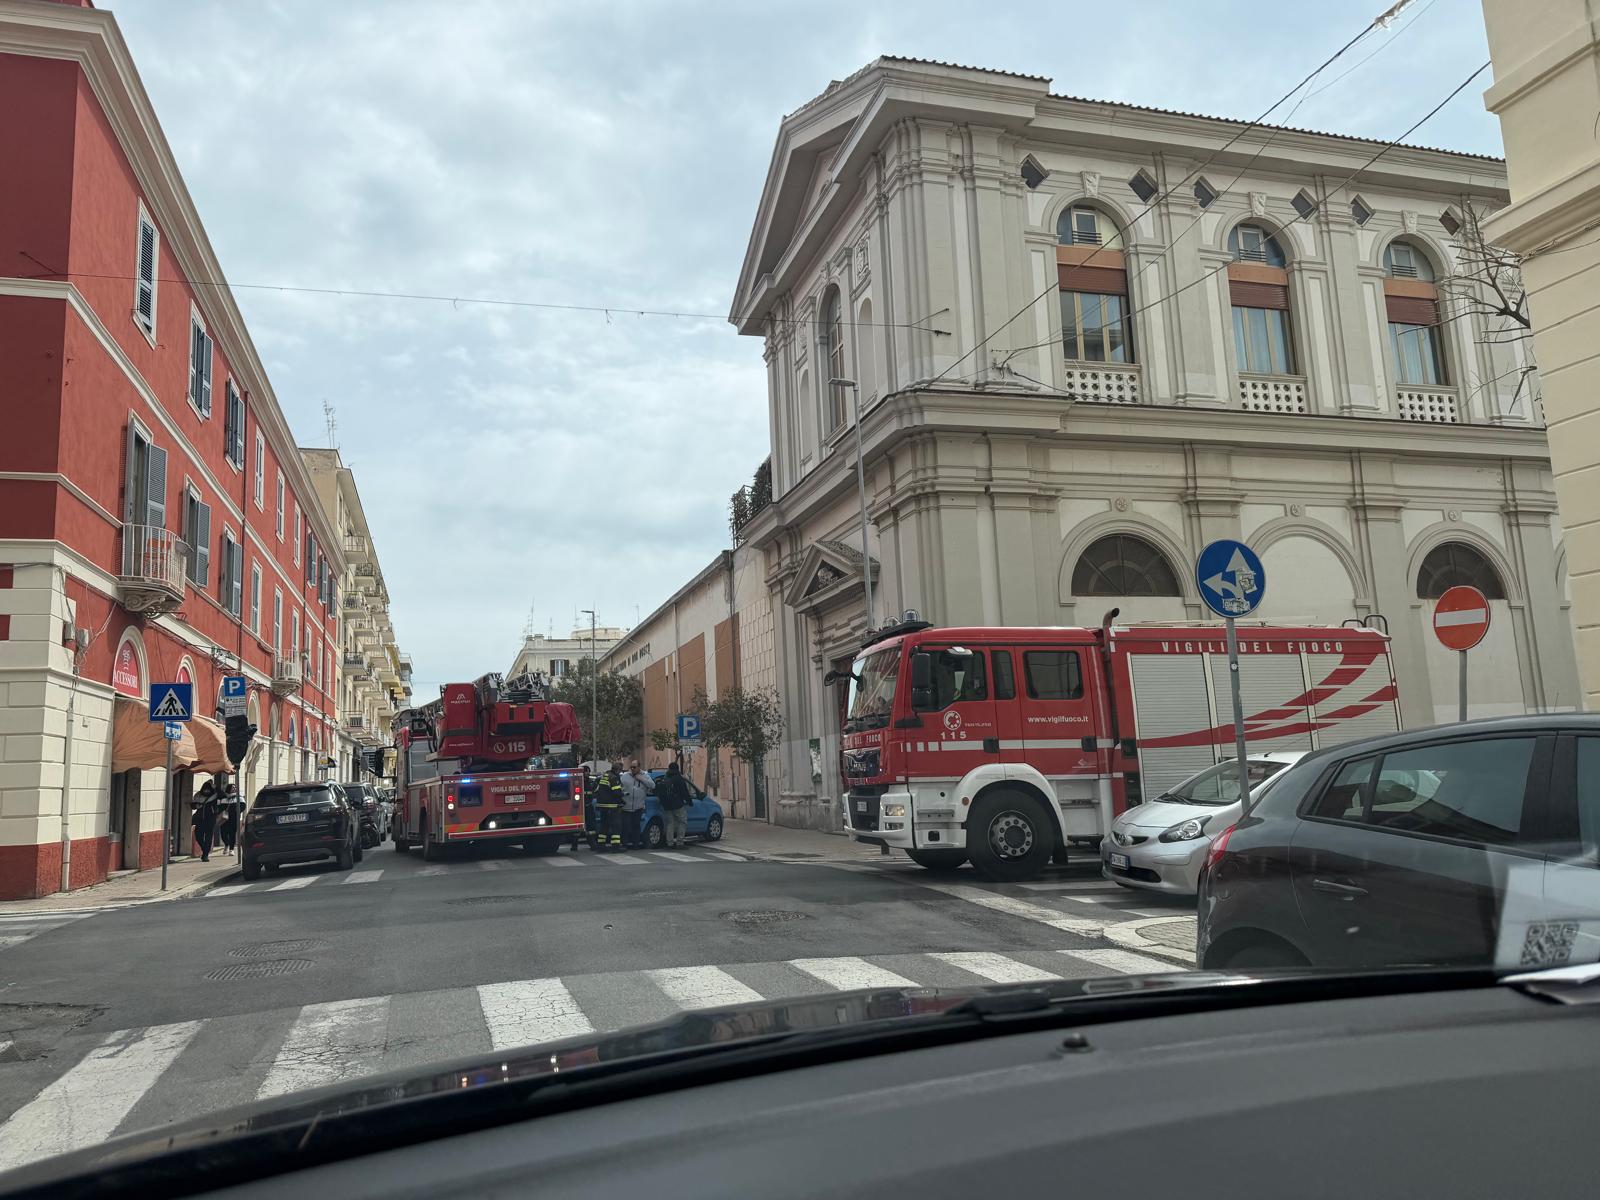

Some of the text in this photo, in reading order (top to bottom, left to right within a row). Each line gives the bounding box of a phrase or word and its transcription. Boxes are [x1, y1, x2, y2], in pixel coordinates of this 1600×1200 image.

[1161, 642, 1343, 653] VIGILI DEL FUOCO
[113, 669, 138, 689] ACCESSORI
[229, 680, 240, 694] P
[1027, 715, 1089, 724] www.vigilfuoco.it
[683, 717, 697, 737] P
[940, 731, 967, 740] 115
[507, 741, 526, 752] 115
[521, 784, 541, 792] FUOCO
